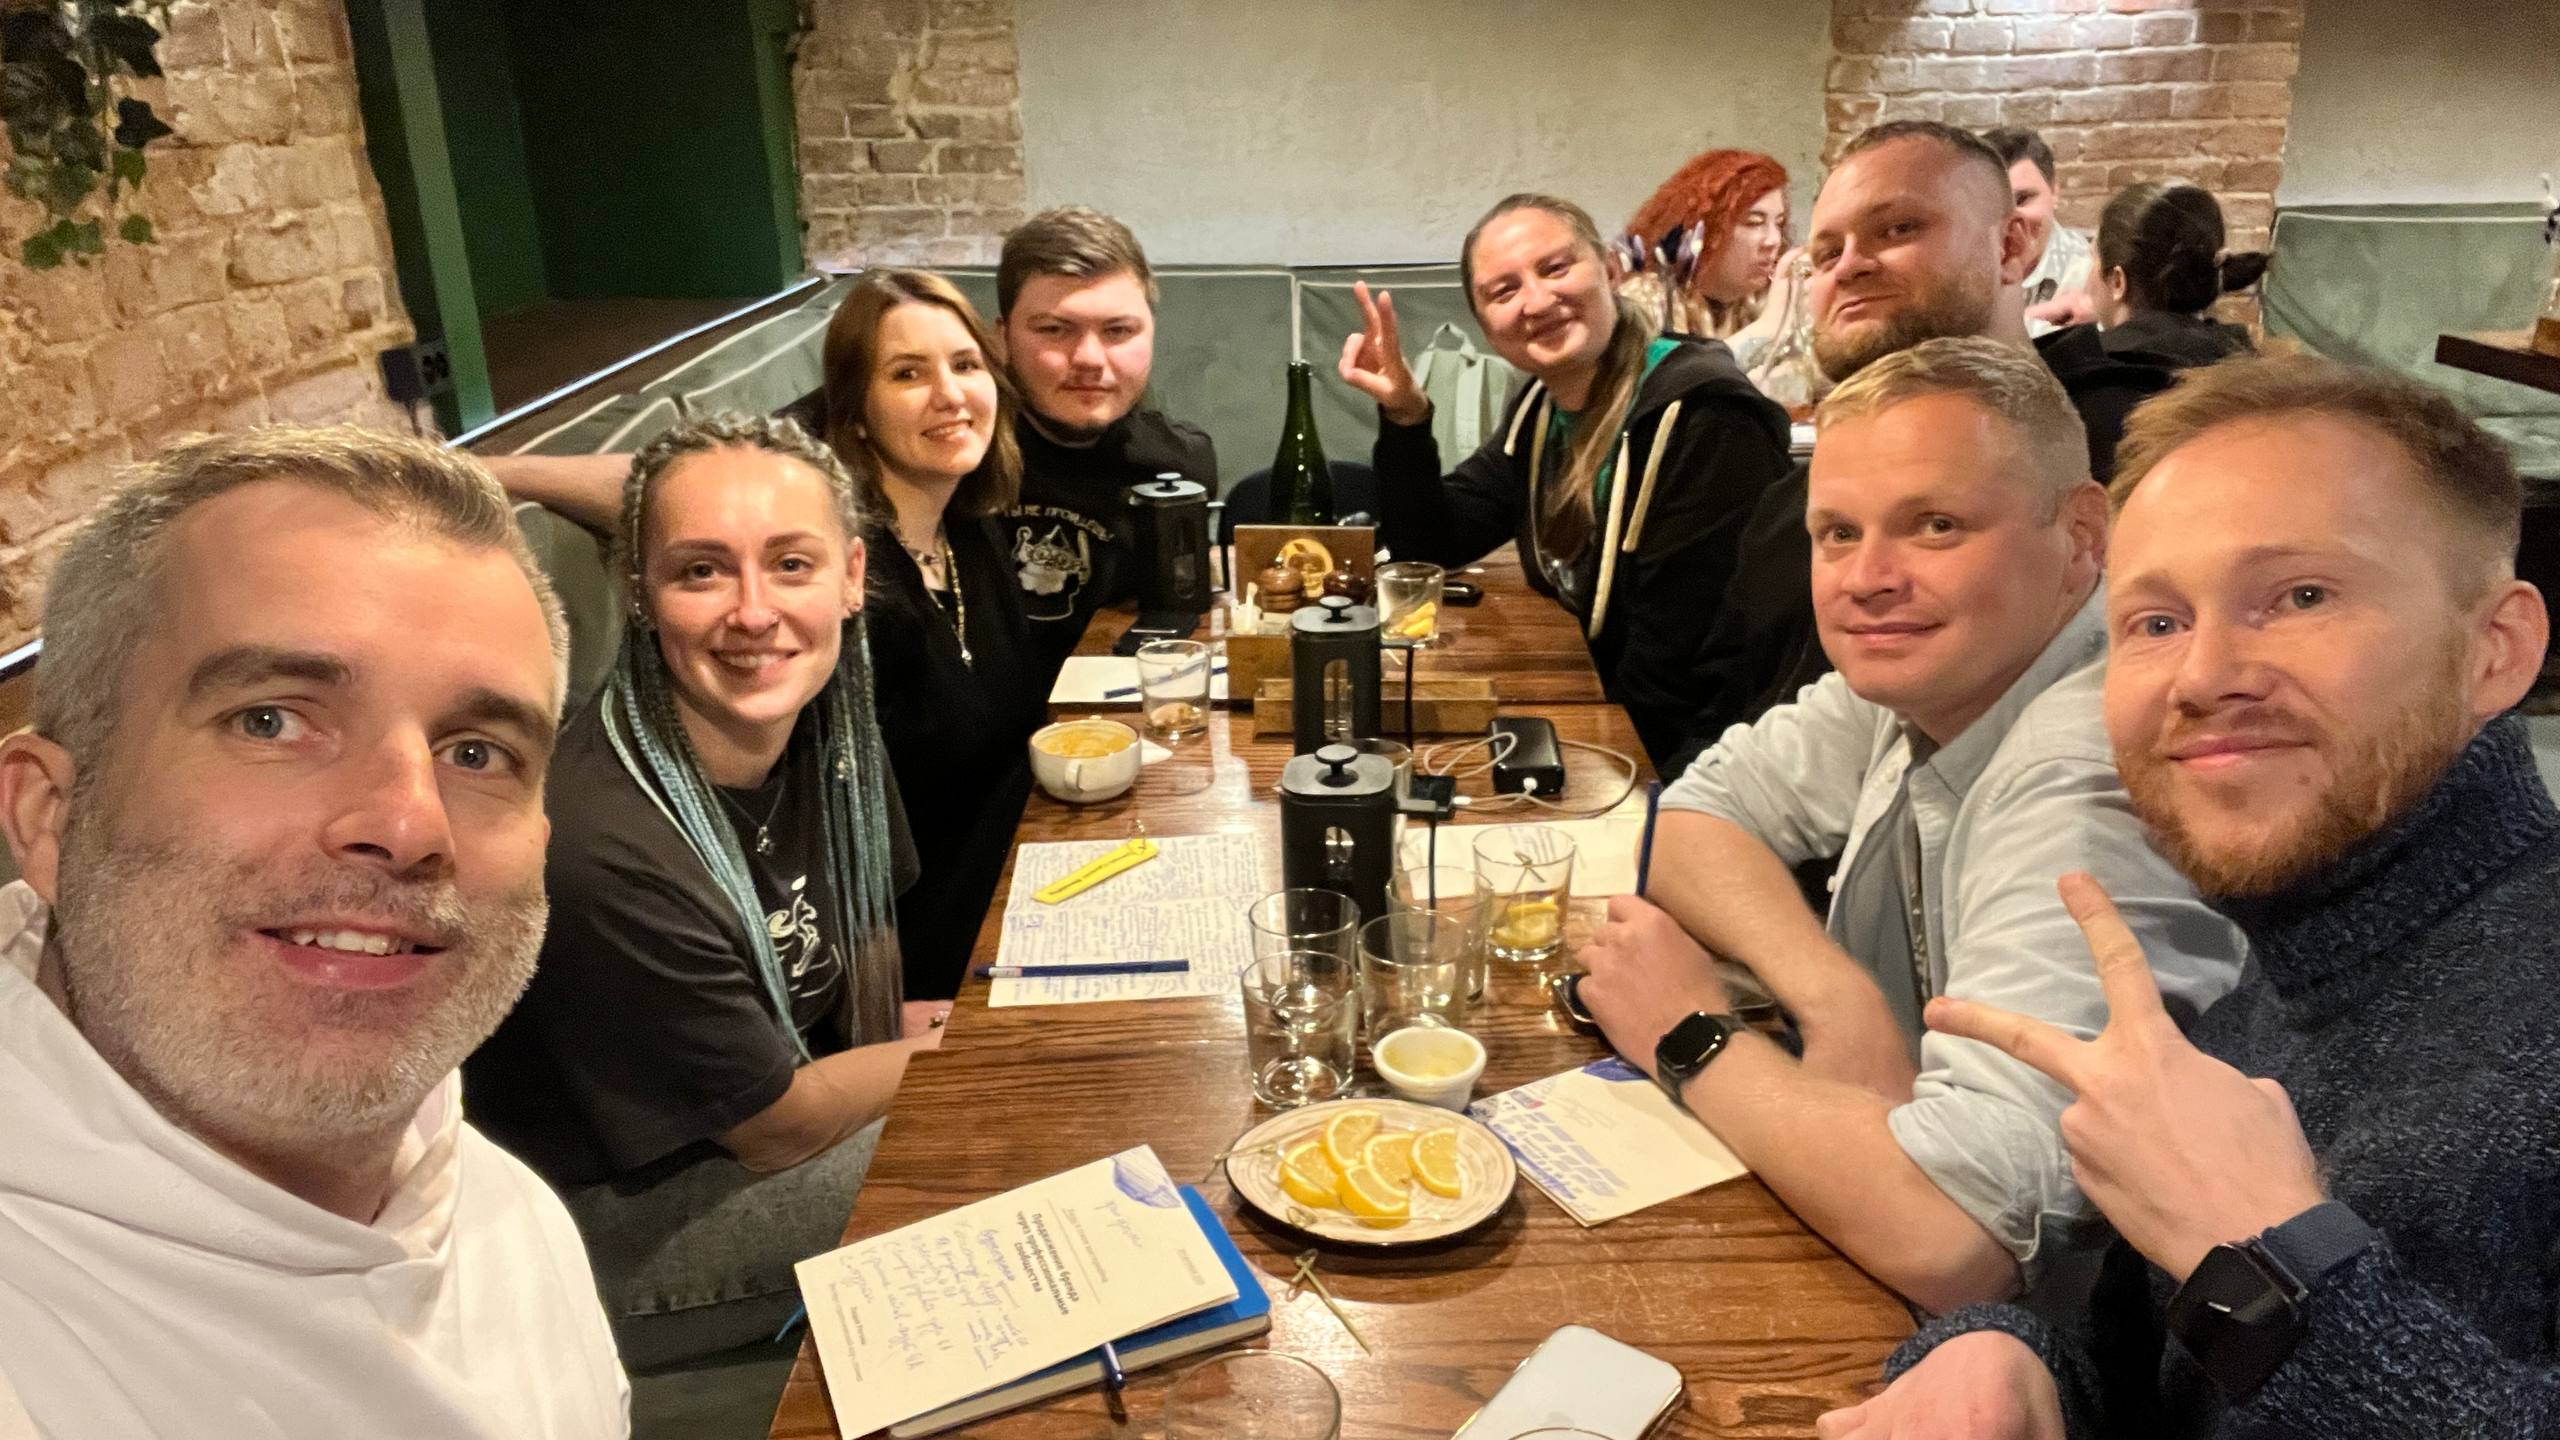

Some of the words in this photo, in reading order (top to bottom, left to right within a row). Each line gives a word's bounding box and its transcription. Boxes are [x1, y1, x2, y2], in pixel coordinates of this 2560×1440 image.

[1014, 1241, 1043, 1293] сообщества
[1016, 1210, 1032, 1235] через
[1026, 1234, 1070, 1316] профессиональные
[1031, 1212, 1065, 1271] Продвижение
[1059, 1270, 1080, 1302] бренда
